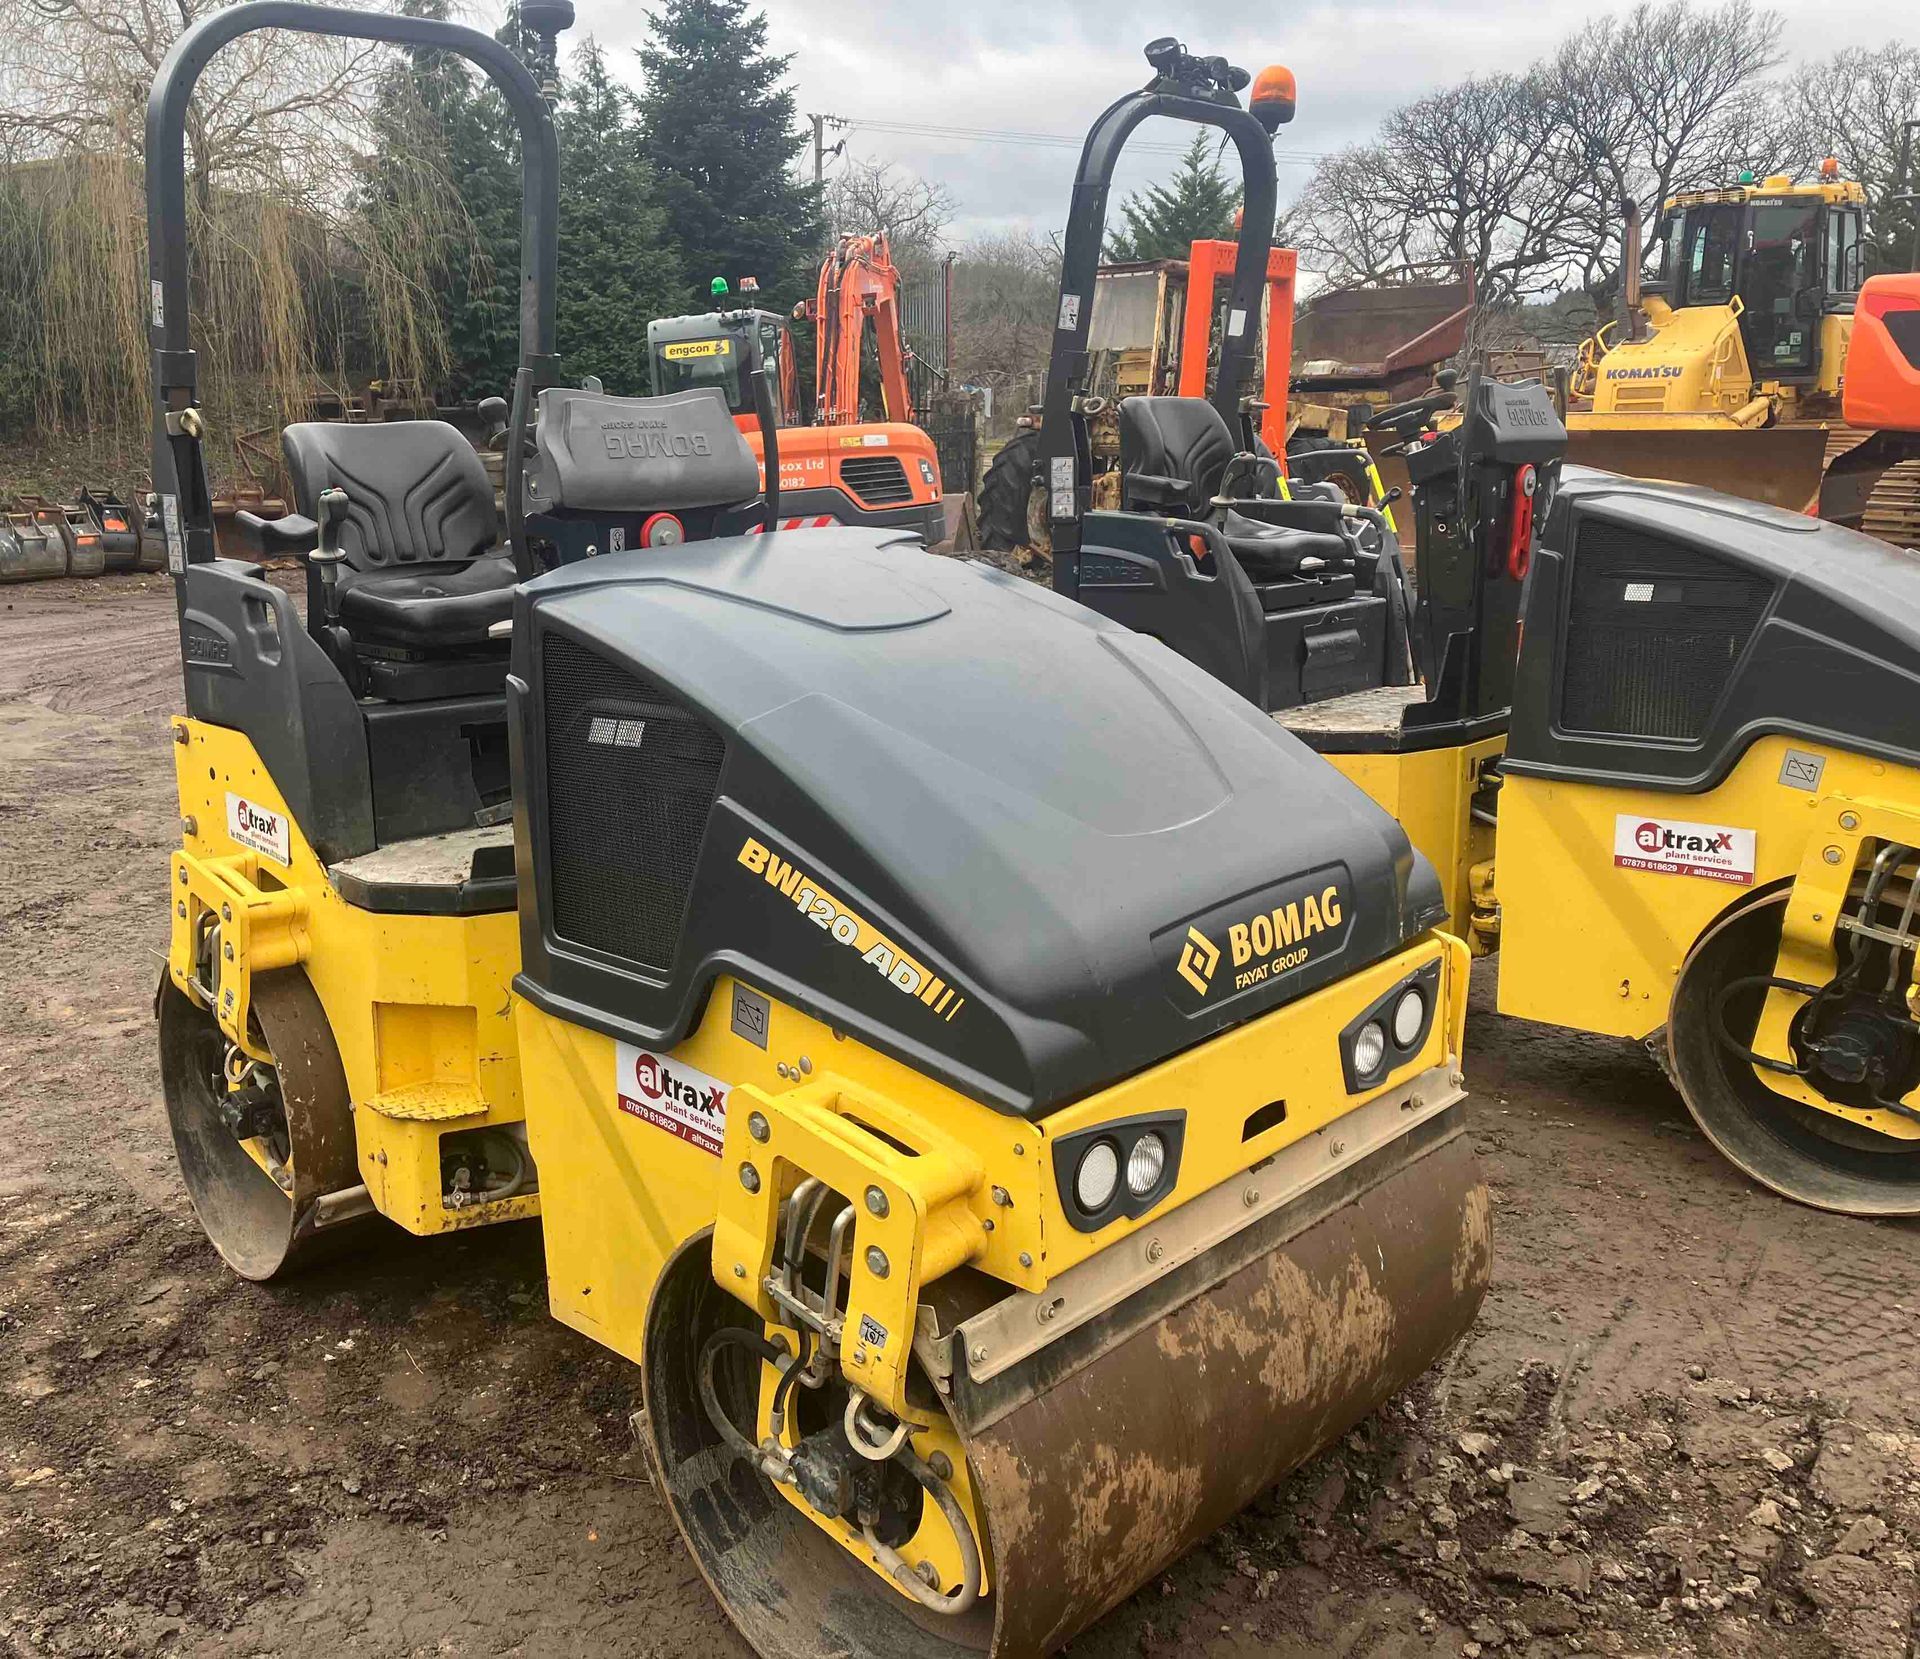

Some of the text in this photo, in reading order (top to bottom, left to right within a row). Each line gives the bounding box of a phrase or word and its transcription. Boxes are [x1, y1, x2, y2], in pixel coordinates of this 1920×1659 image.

[669, 345, 709, 356] engcon
[1606, 365, 1683, 379] KOMATSU
[602, 432, 712, 459] BOMAG
[806, 459, 824, 470] Ltd
[1622, 858, 1646, 868] 07879
[1647, 862, 1678, 872] 618629
[1693, 868, 1744, 882] altraxx.com
[1665, 851, 1733, 866] plant services
[1228, 886, 1342, 967] BOMAG
[861, 942, 922, 994] AD
[1235, 947, 1308, 990] FAYAT GROUP
[665, 1101, 688, 1119] plant
[626, 1100, 649, 1118] 07879
[649, 1111, 678, 1132] 618629
[691, 1133, 723, 1155] altraxx.
